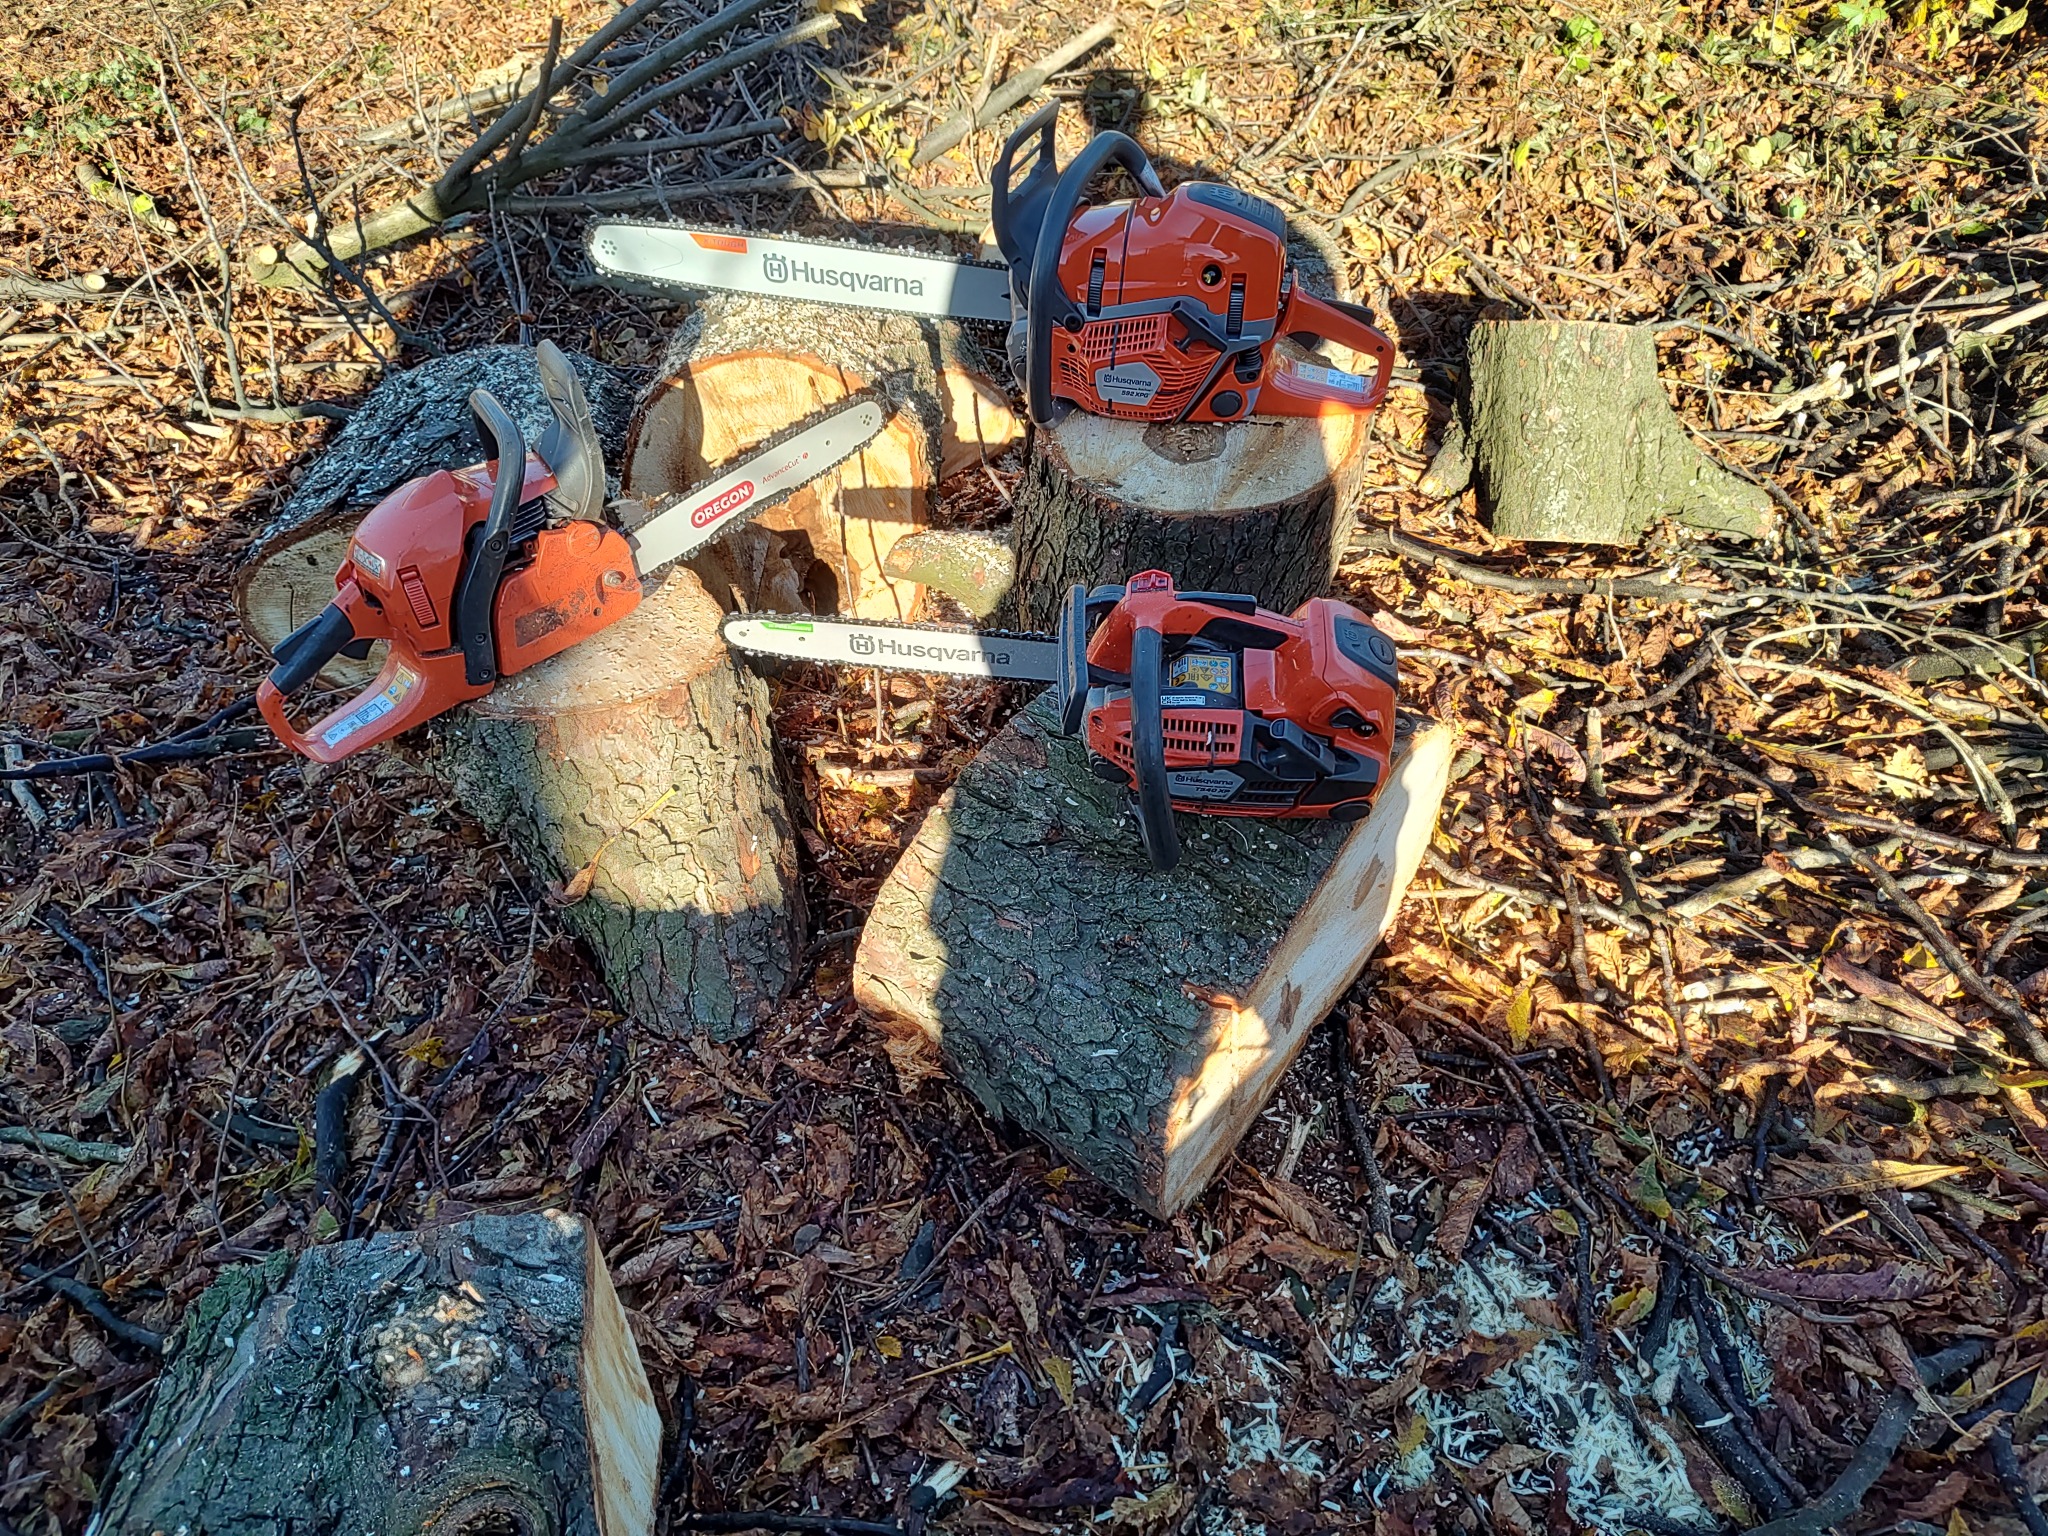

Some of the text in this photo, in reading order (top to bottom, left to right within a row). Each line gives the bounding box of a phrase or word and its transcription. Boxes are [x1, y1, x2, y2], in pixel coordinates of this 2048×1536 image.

[791, 260, 924, 297] Husqvarna
[1112, 375, 1152, 387] Husqvarna
[694, 485, 750, 525] OREGON
[878, 638, 1011, 665] Husqvarna
[1185, 775, 1234, 786] Husqvarna
